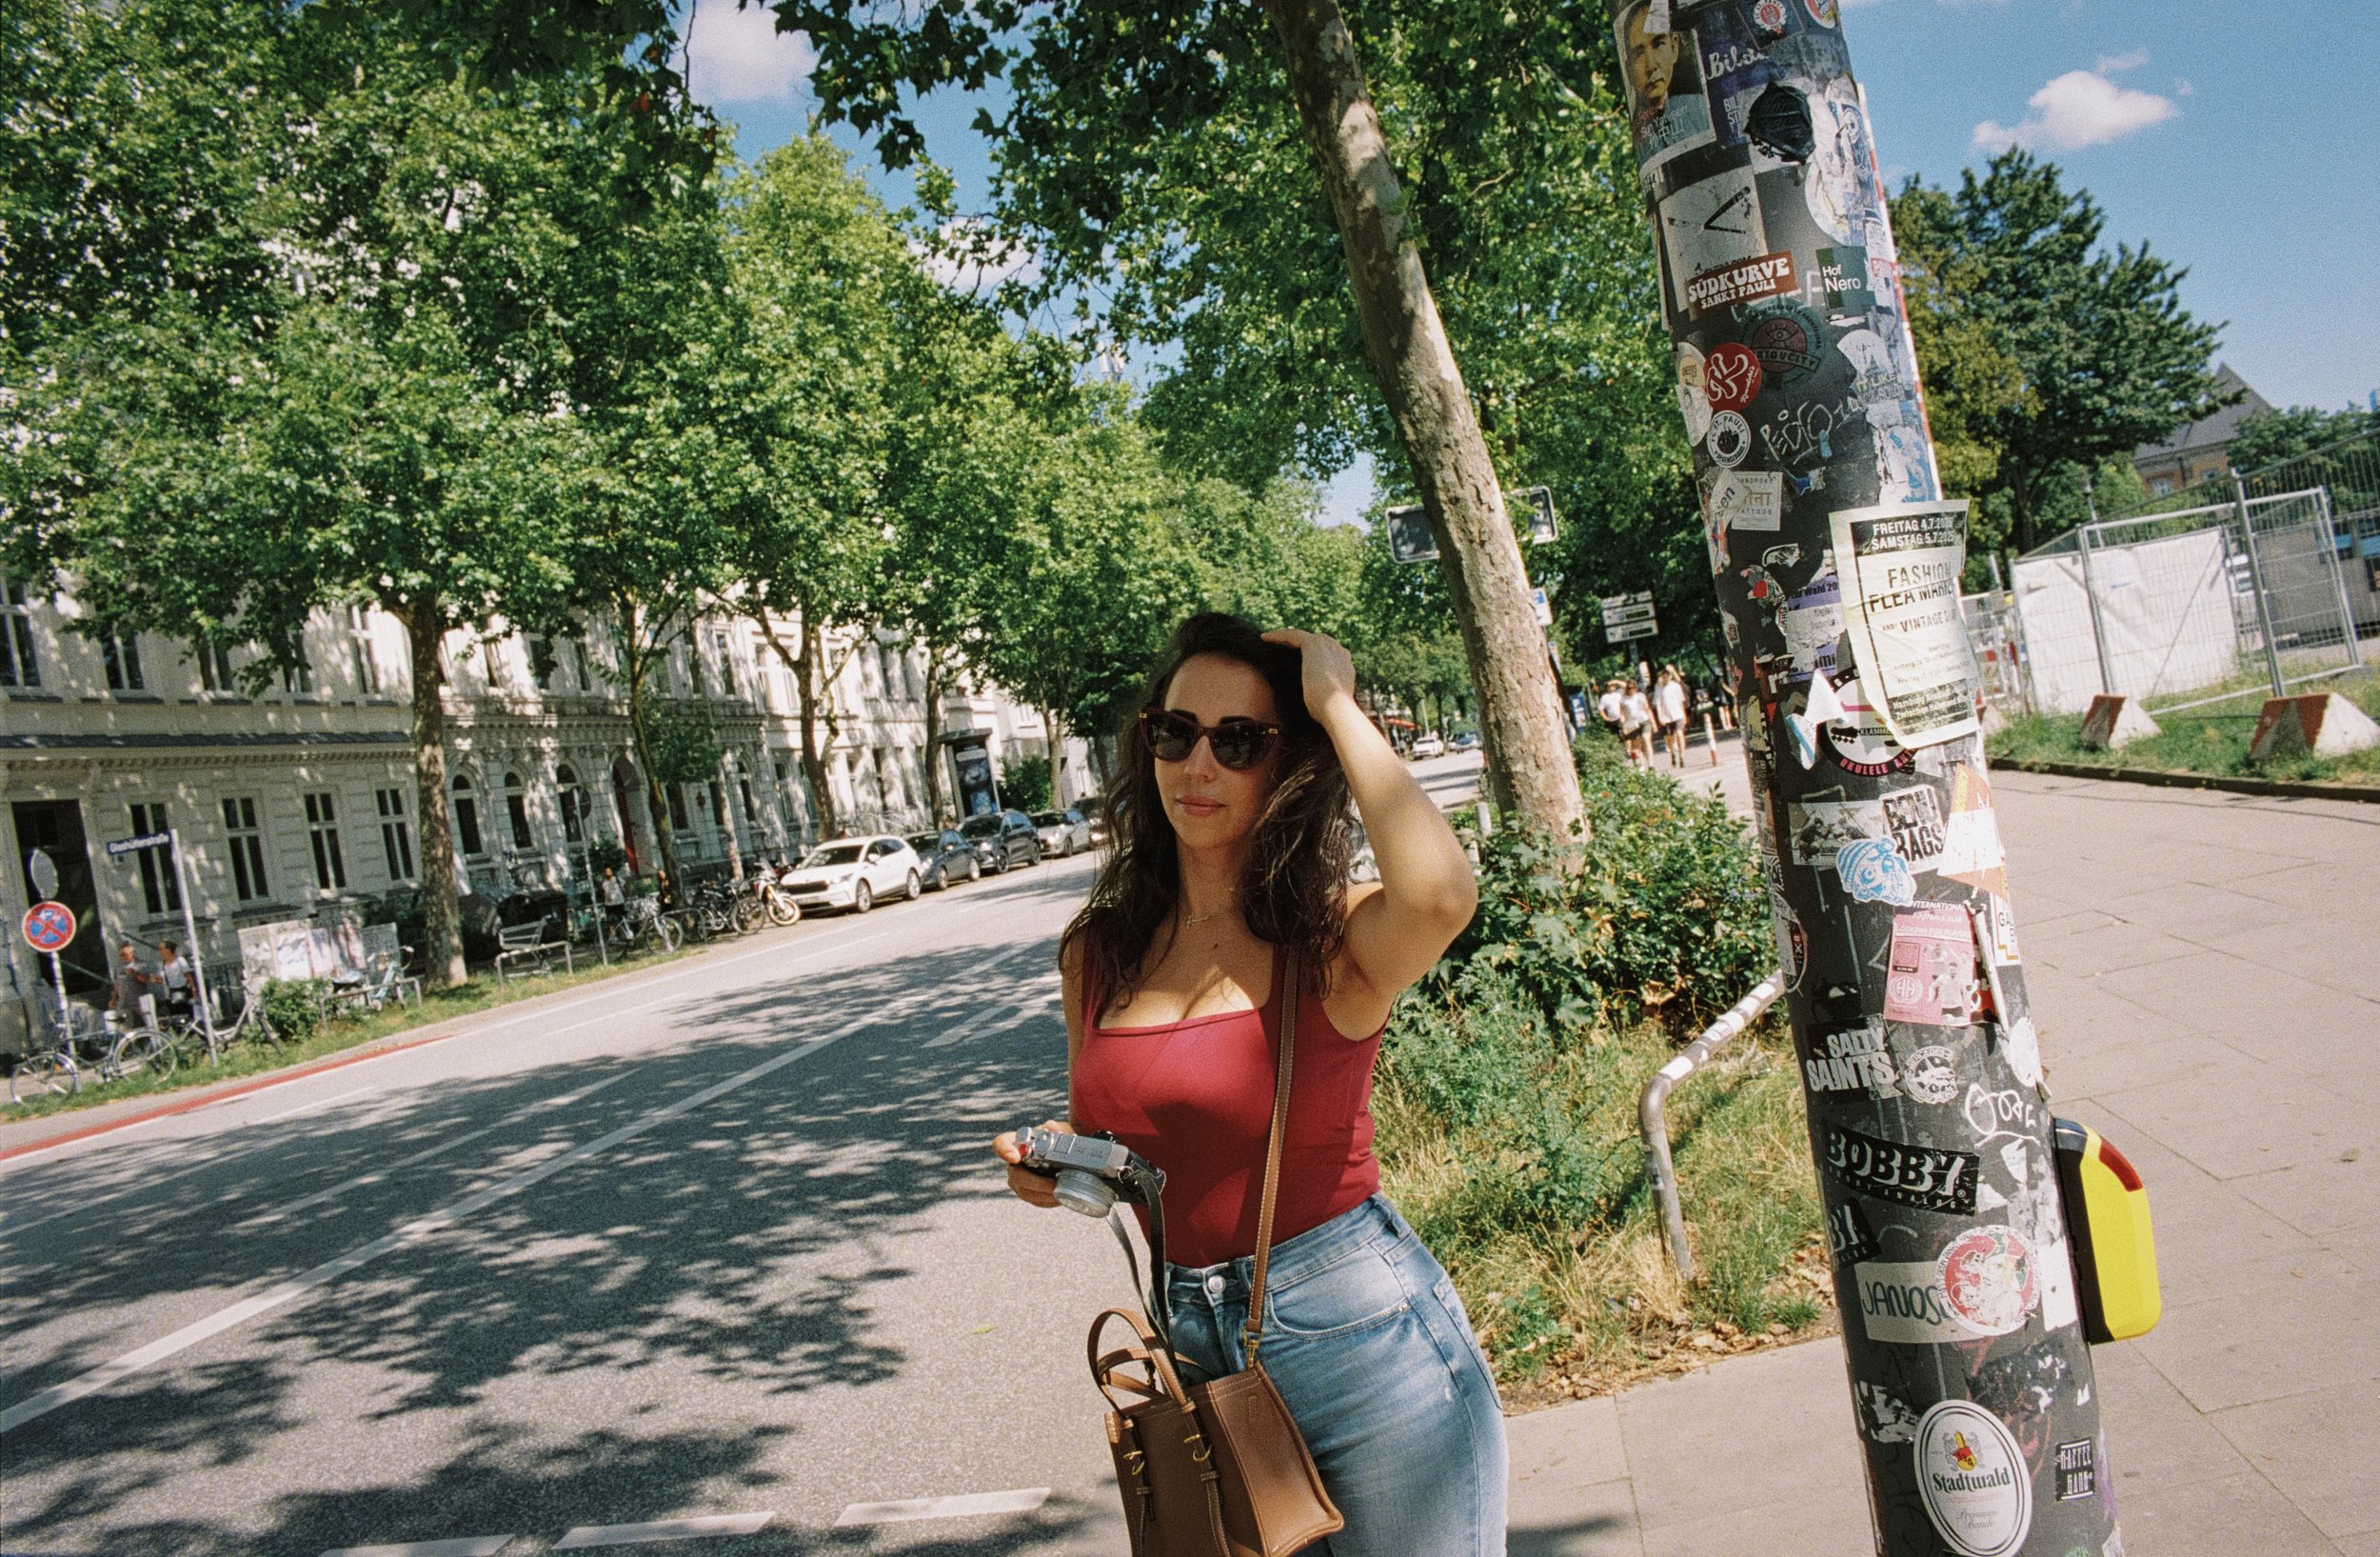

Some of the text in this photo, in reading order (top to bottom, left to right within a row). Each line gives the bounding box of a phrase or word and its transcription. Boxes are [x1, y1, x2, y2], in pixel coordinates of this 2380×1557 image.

[1687, 257, 1790, 303] SÜDKURVE
[1822, 264, 1842, 277] Hof
[1701, 278, 1776, 309] SANKT PAULI
[1825, 277, 1861, 292] Nero
[1723, 414, 1746, 435] PAULI
[1873, 519, 1918, 535] FREITAG
[1872, 533, 1923, 549] SAMSTAG
[1887, 560, 1952, 589] FASHION
[1869, 590, 1915, 612] FLEA
[1899, 611, 1943, 633] VINTAGE
[1839, 758, 1888, 776] UKULELE
[1893, 824, 1944, 863] RAGS
[1826, 1027, 1885, 1059] SALTY
[1806, 1051, 1895, 1092] SAINTS
[1826, 1131, 1966, 1197] BOBBY
[1883, 1188, 1957, 1209] ANALOG
[1932, 1467, 2011, 1494] Stadtwald
